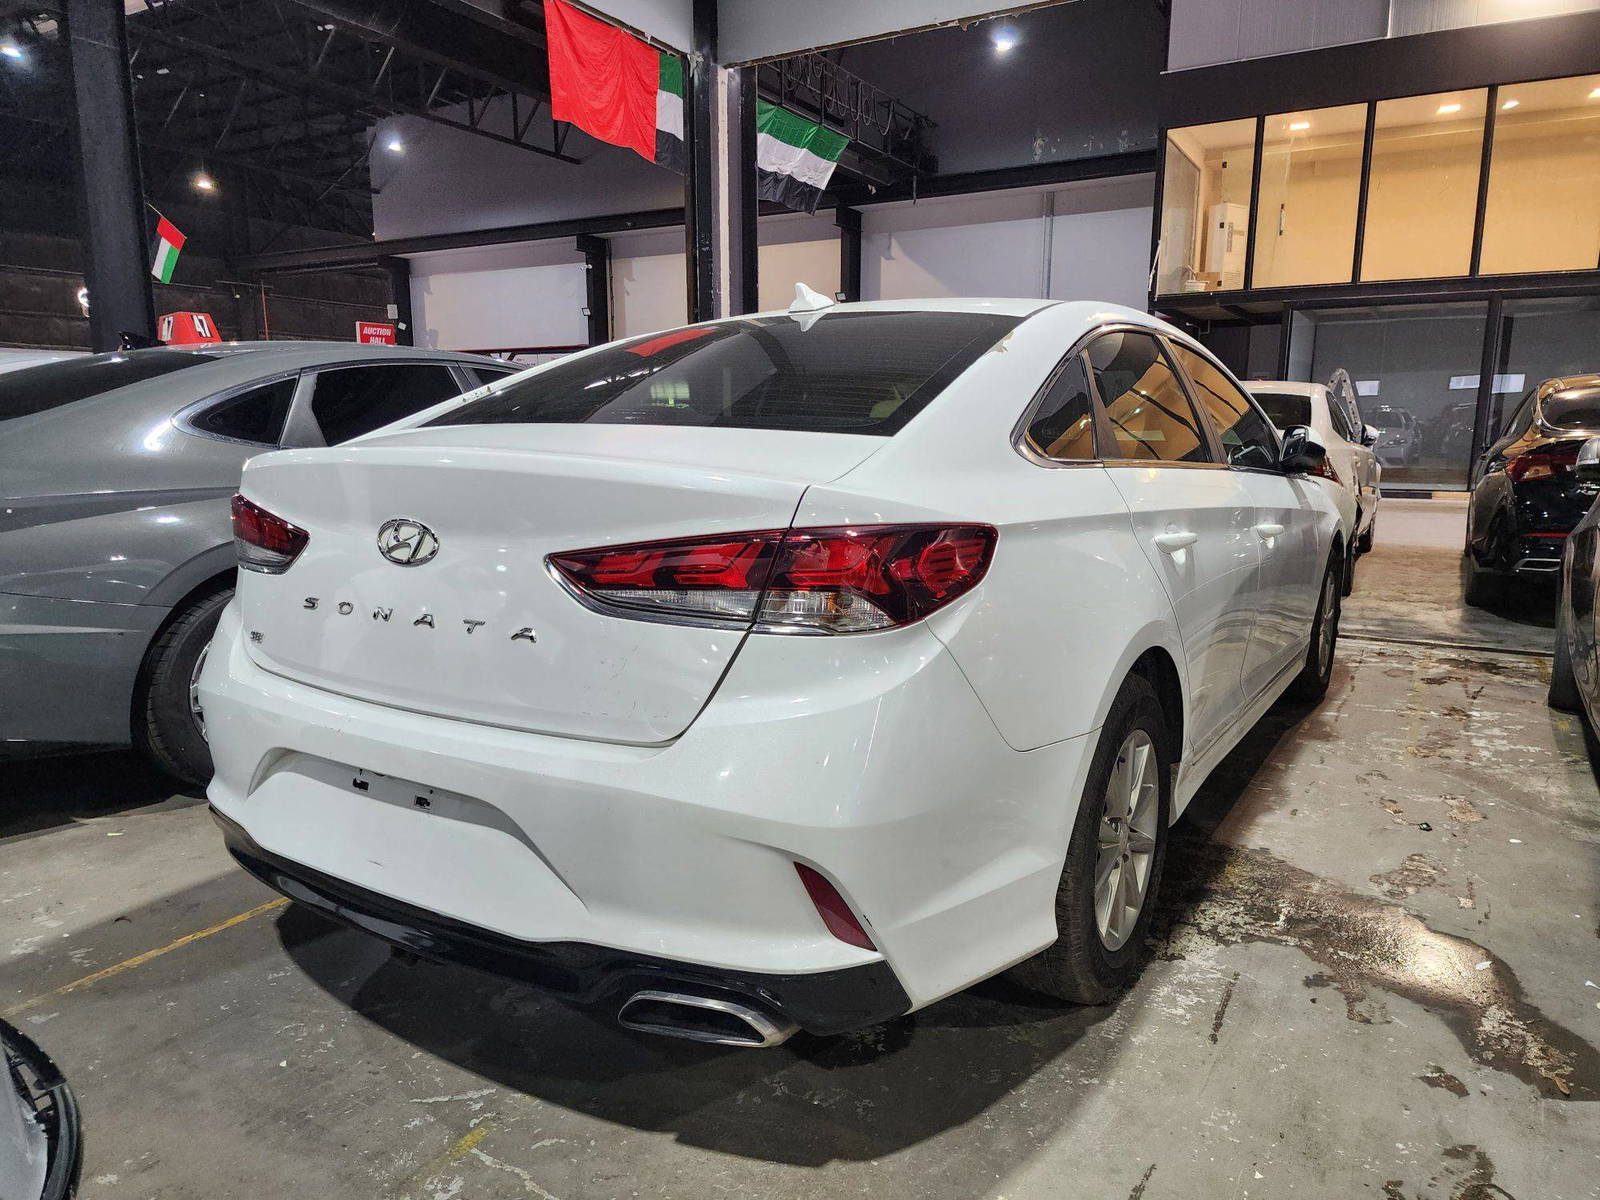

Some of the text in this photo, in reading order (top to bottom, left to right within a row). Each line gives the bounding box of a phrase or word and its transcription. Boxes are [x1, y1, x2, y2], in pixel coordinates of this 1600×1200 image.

[191, 314, 213, 338] 47
[362, 326, 392, 337] AUCTION
[370, 336, 386, 345] HALL
[302, 596, 538, 644] SONATA
